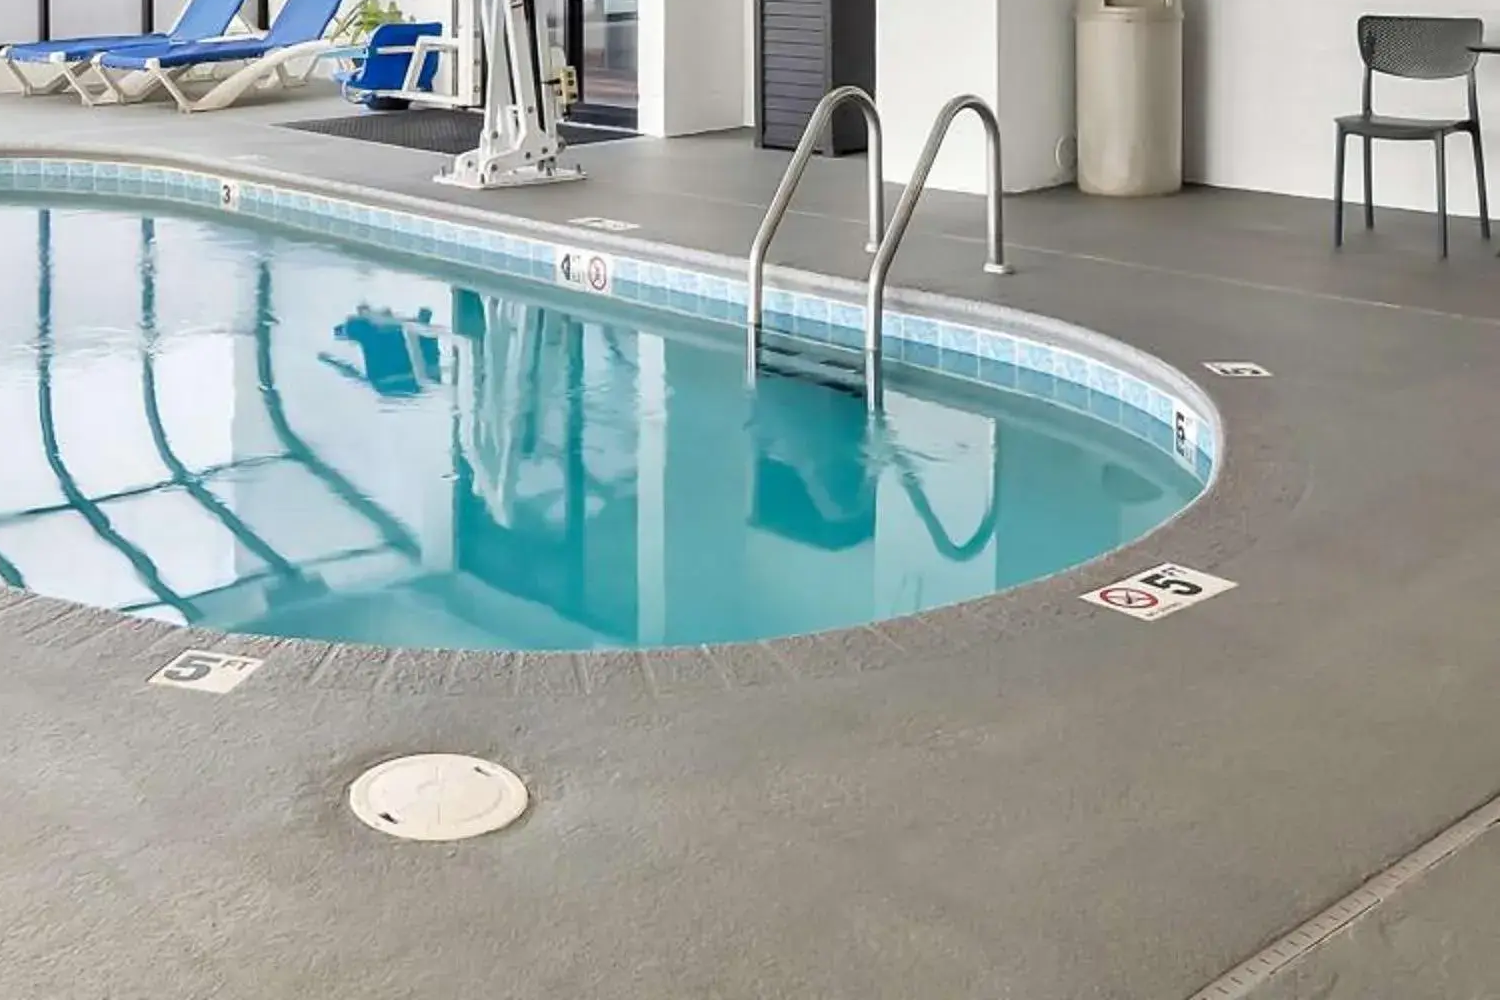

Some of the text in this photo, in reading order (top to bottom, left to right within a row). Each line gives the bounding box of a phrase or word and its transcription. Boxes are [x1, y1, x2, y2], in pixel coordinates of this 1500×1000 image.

[1140, 573, 1203, 596] 5
[163, 655, 251, 682] 5 FT
